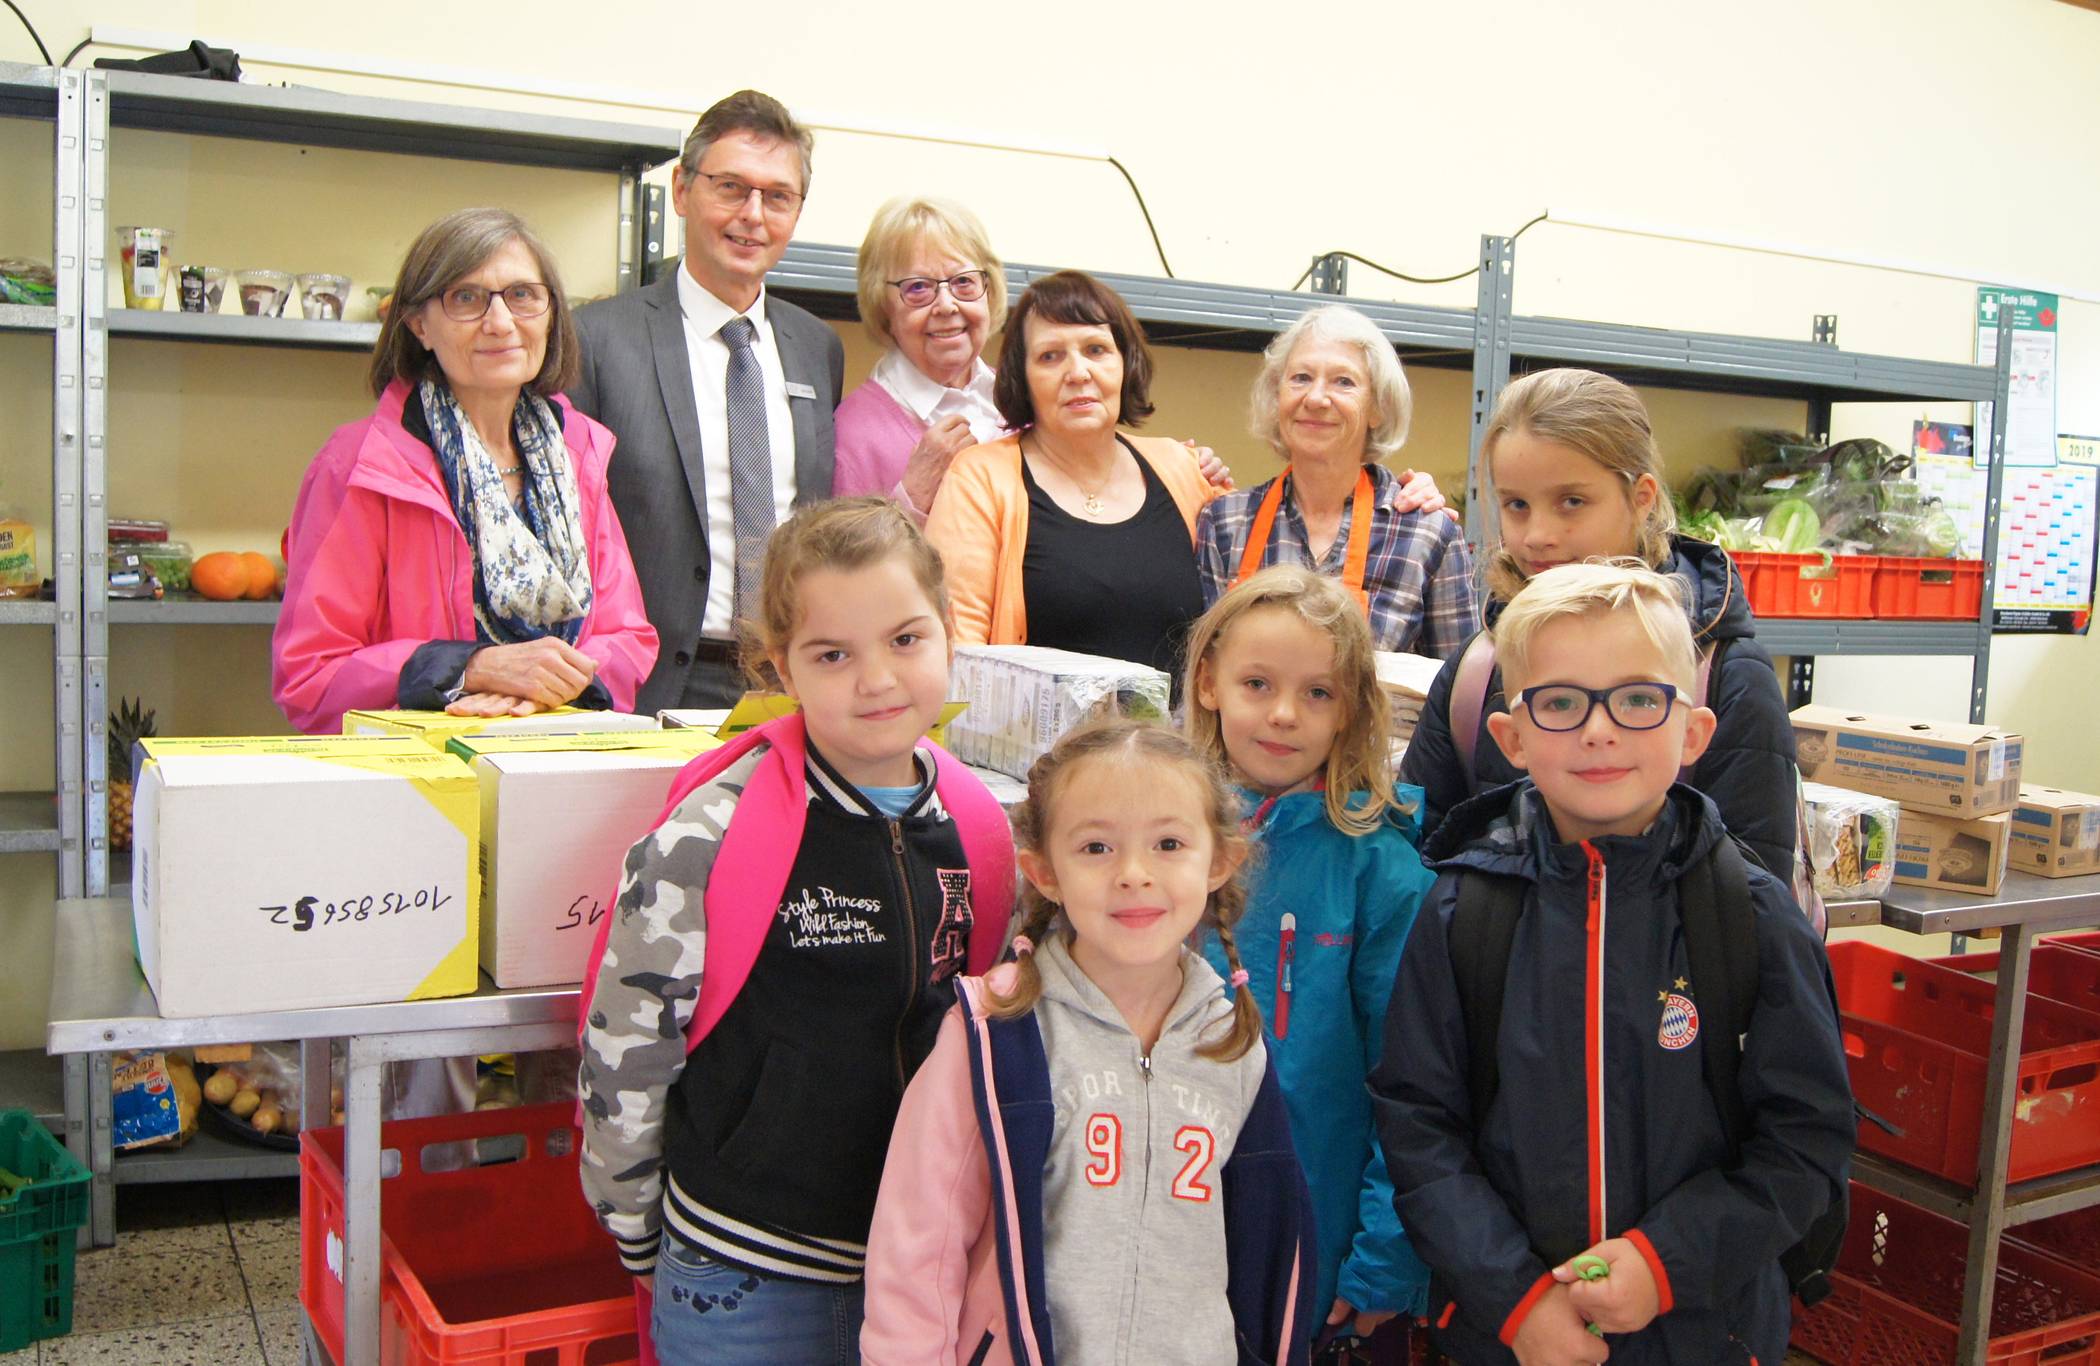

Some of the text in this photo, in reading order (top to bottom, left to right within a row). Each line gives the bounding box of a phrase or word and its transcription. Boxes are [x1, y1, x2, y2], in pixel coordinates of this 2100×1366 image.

[2069, 444, 2094, 458] 2019
[778, 886, 881, 923] Style Princess
[827, 912, 868, 931] Fashion
[822, 930, 853, 945] make
[865, 926, 887, 943] Fun
[1664, 997, 1696, 1018] AYERN
[1085, 1112, 1216, 1204] 9 2
